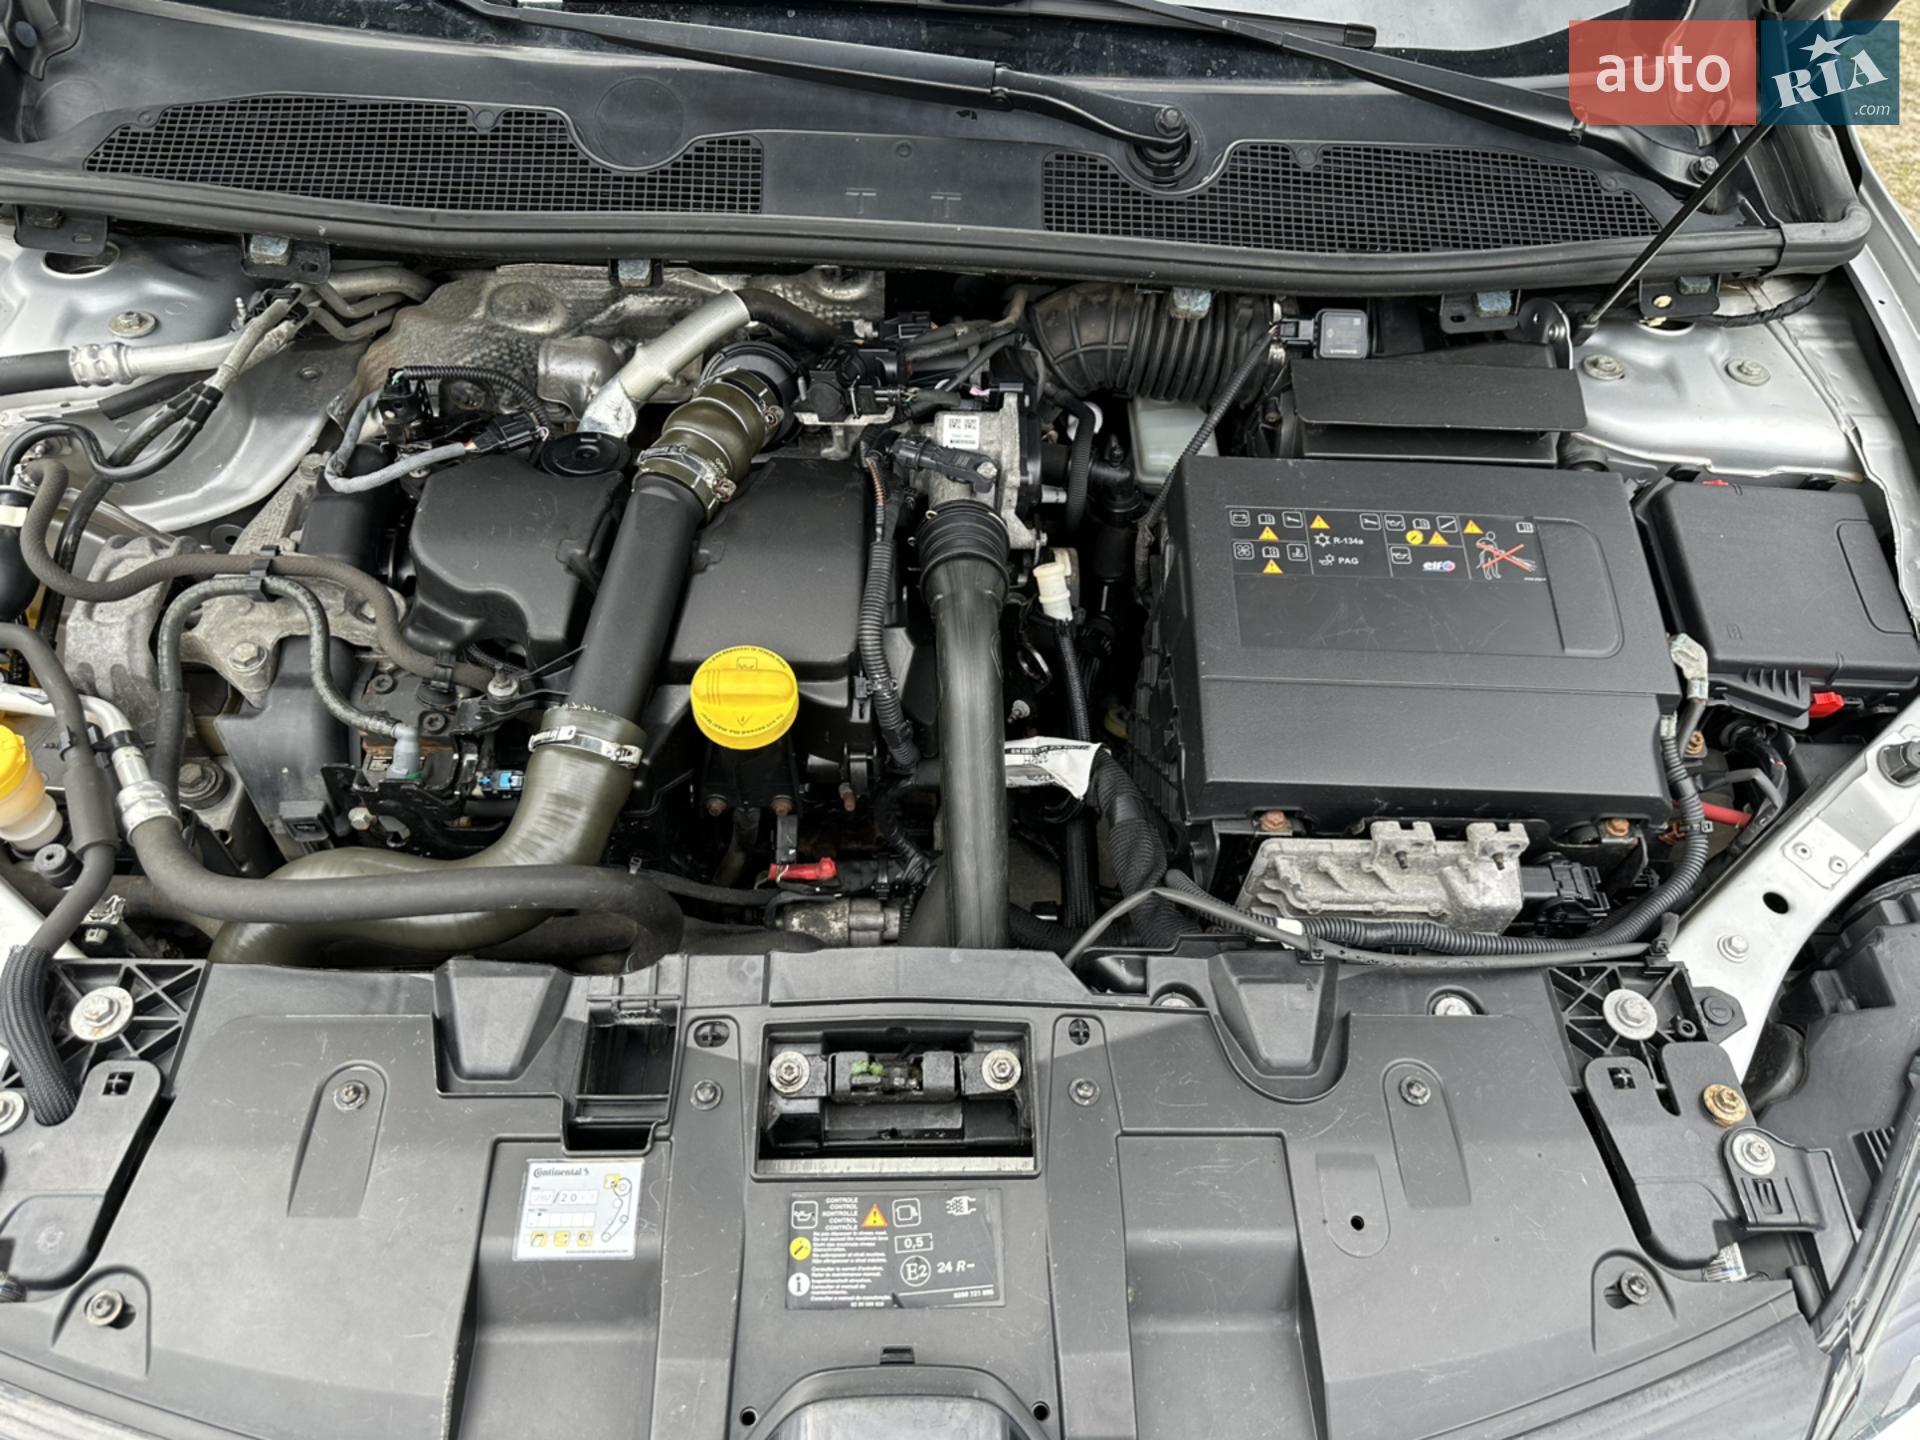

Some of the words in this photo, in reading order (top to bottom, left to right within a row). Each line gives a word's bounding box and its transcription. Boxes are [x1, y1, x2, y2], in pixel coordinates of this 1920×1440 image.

[1333, 537, 1364, 545] R-134a
[1338, 557, 1359, 565] PAG
[533, 1168, 582, 1178] Continental
[903, 1236, 924, 1250] 0,5
[906, 1262, 928, 1281] E2
[936, 1260, 953, 1274] 24
